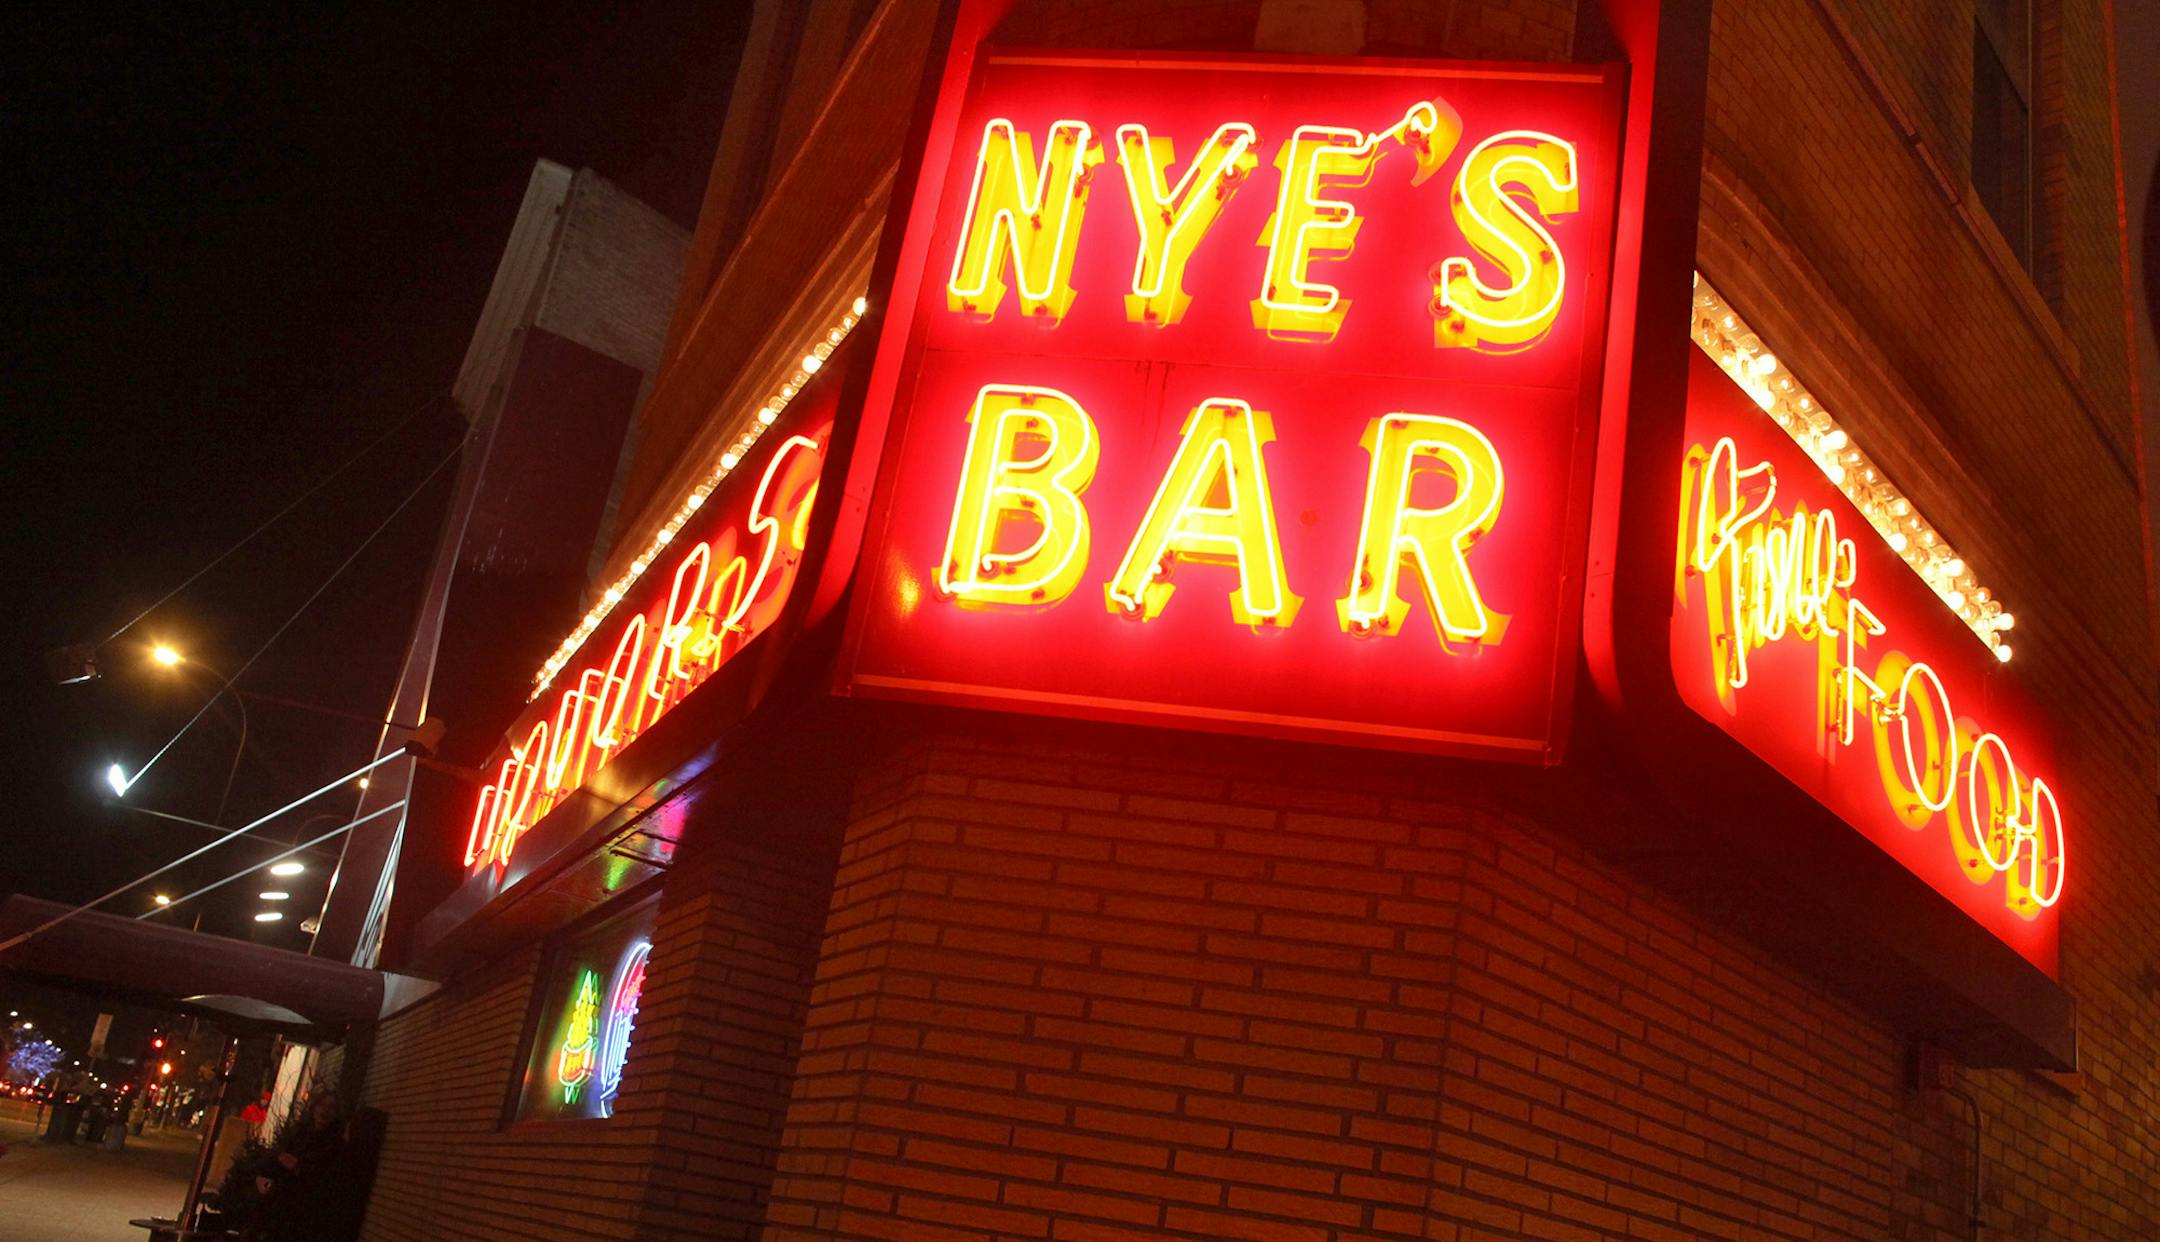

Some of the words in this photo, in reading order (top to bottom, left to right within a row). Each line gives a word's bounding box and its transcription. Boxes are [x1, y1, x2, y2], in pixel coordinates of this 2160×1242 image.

[946, 98, 1579, 352] NYE'S
[932, 384, 1510, 652] BAR
[1820, 598, 2066, 915] FOOD
